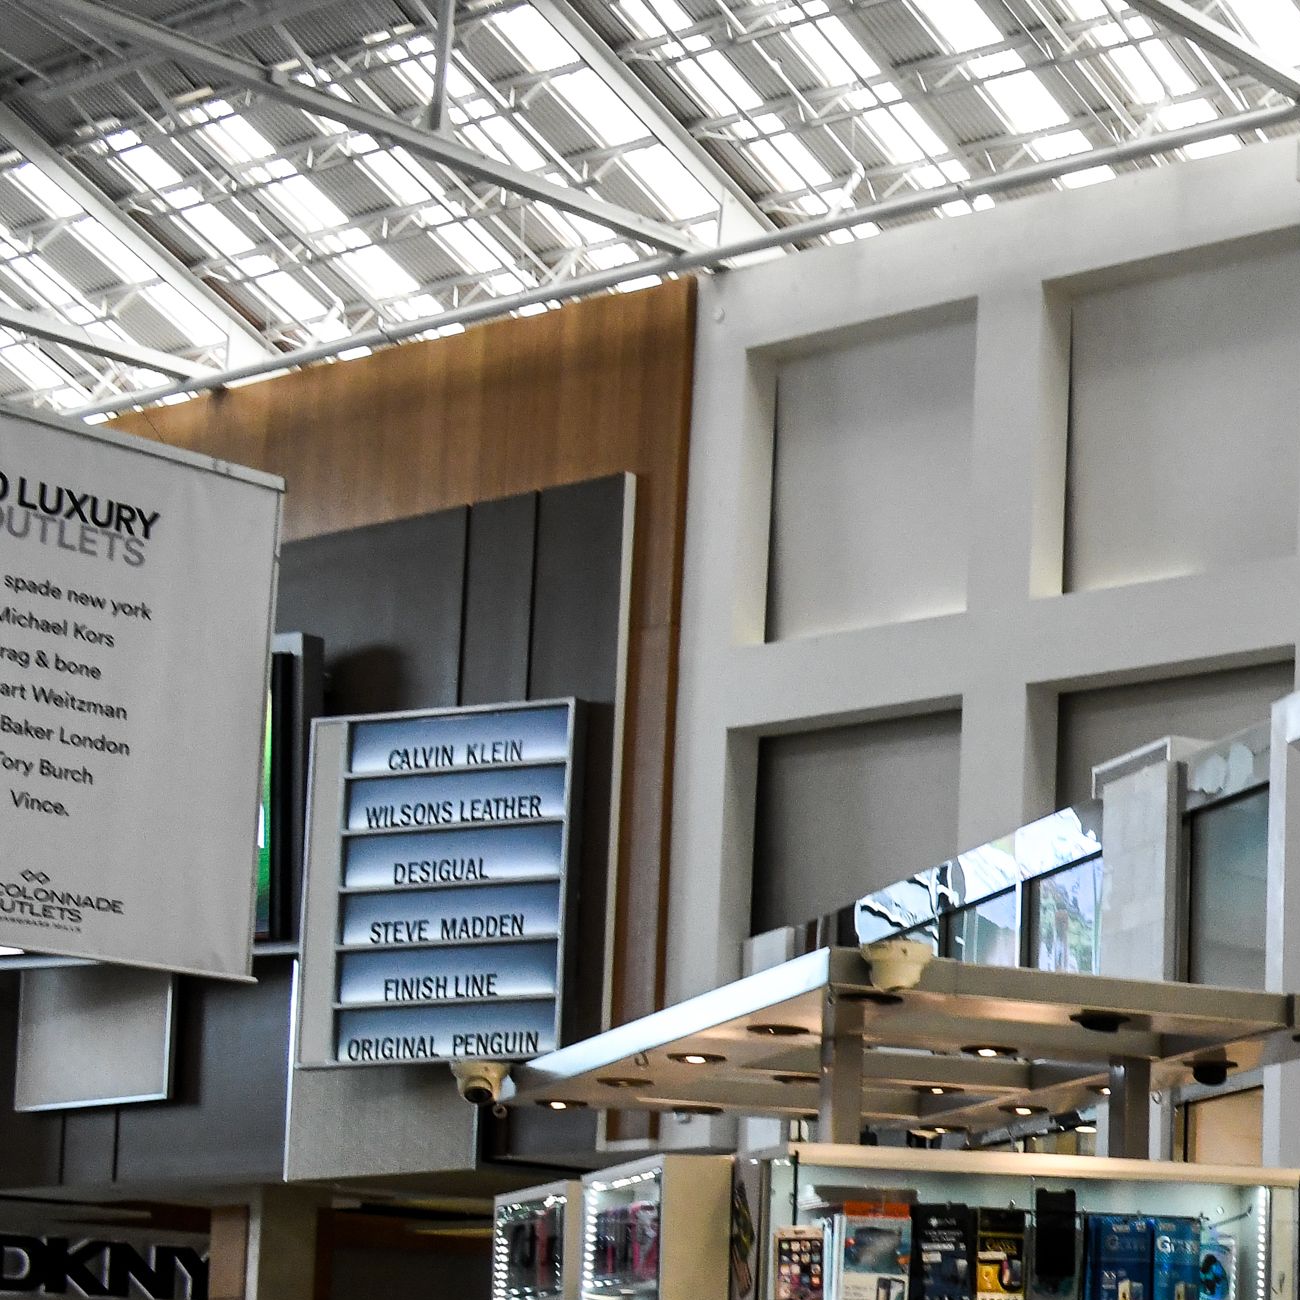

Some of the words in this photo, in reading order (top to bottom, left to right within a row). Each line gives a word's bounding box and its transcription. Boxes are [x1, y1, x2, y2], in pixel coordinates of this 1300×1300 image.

[17, 476, 161, 540] LUXURY
[0, 505, 146, 568] UTLETS
[4, 573, 63, 594] spade
[67, 588, 107, 610] new
[110, 599, 152, 622] york
[73, 621, 115, 648] Kors
[35, 649, 50, 670] &
[54, 652, 102, 680] bone
[31, 683, 128, 721] Weitzman
[0, 714, 55, 741] Baker
[59, 726, 130, 756] London
[0, 752, 33, 777] ory
[39, 758, 94, 785] Burch
[388, 744, 454, 771] CALVIN
[466, 739, 524, 764] KLEIN
[10, 788, 70, 817] Vince.
[365, 801, 453, 829] WILSONS
[459, 794, 542, 822] LEATHER
[393, 857, 490, 884] DESIGUAL
[369, 919, 430, 944] STEVE
[440, 913, 525, 940] MADDEN
[383, 976, 448, 1001] FINISH
[454, 973, 498, 997] LINE
[347, 1035, 440, 1062] ORIGINAL
[452, 1031, 539, 1056] PENGUIN
